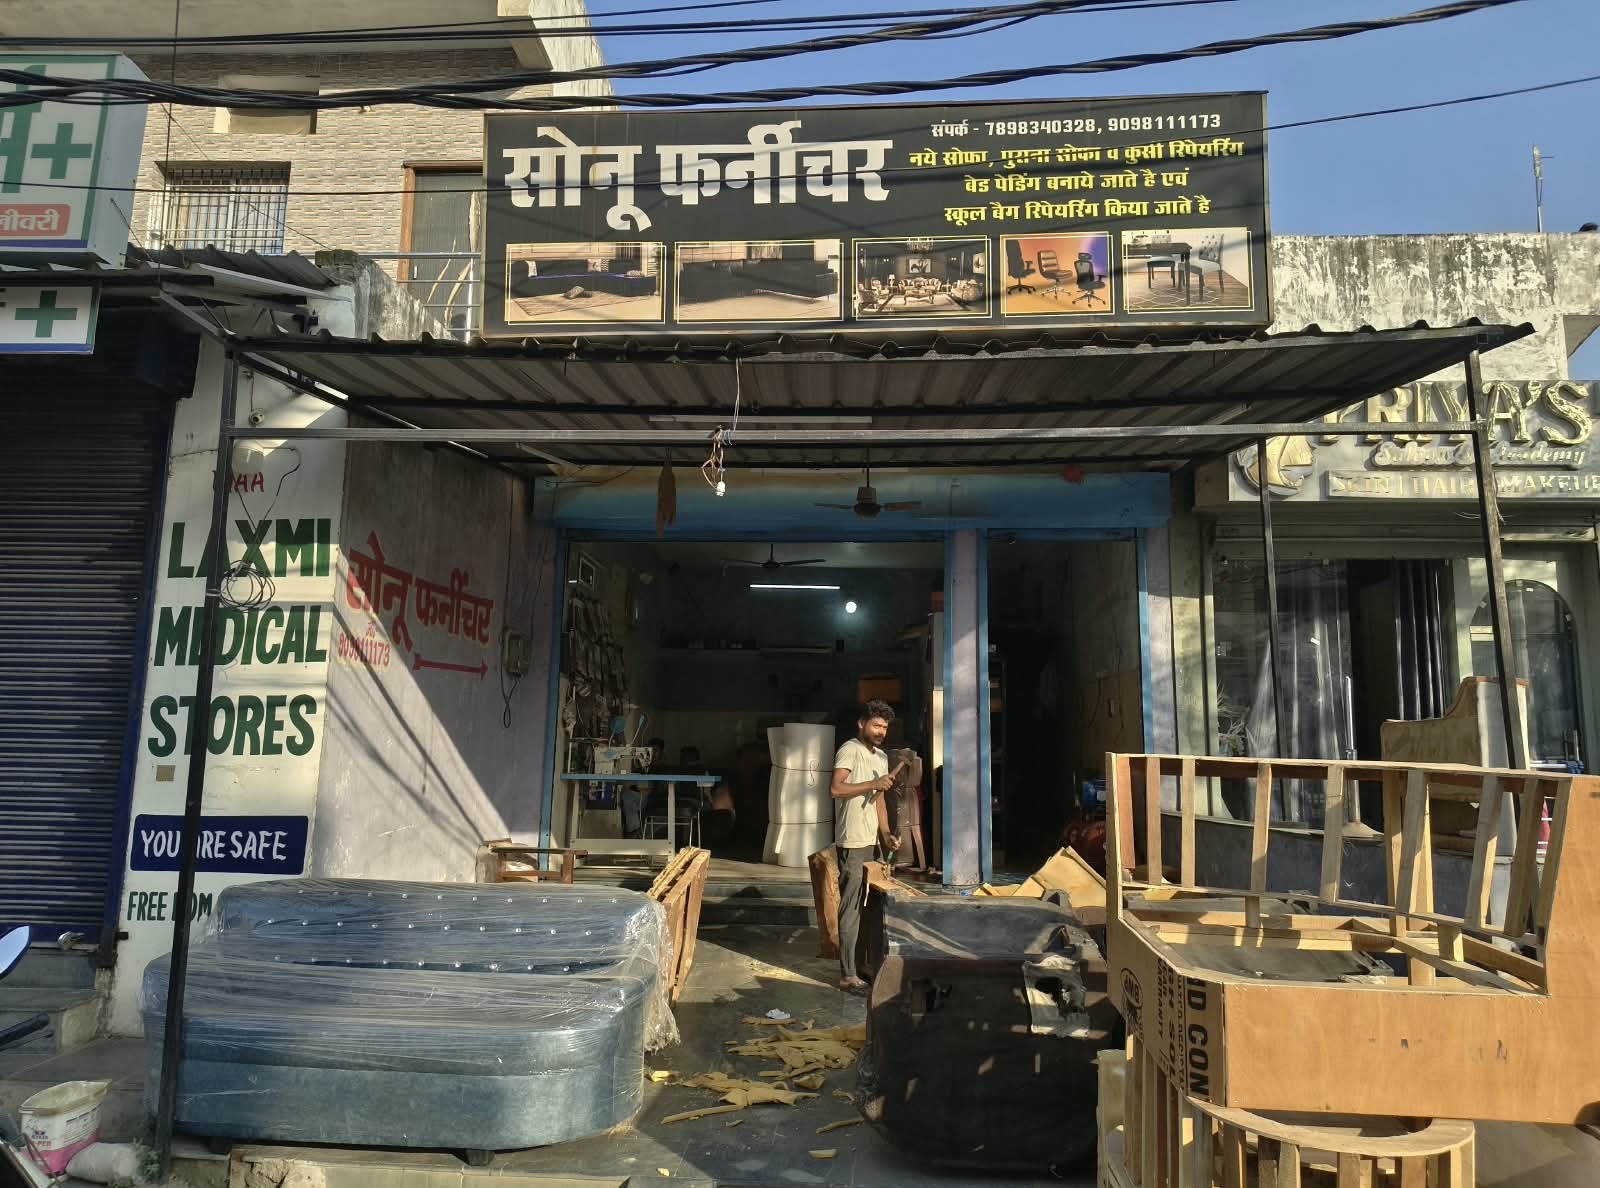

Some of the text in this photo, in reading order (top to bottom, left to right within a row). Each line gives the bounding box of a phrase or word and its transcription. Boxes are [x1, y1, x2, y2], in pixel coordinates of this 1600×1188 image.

[931, 119, 969, 137] संपर्क
[985, 119, 1102, 136] 7898340328,
[1108, 114, 1221, 131] 9098111173
[909, 148, 937, 166] नये
[1169, 138, 1244, 158] रिपेयरिंग
[502, 120, 893, 232] सोनू फर्नीचर
[965, 167, 1190, 193] बेड पेडिंग बनाये जाते है एवं
[944, 194, 1211, 226] स्कूल बैग रिपेयरिंग किया जाते है
[346, 529, 413, 653] सोनू
[140, 829, 181, 858] YOU
[230, 830, 289, 861] SAFE
[127, 891, 168, 921] FREE
